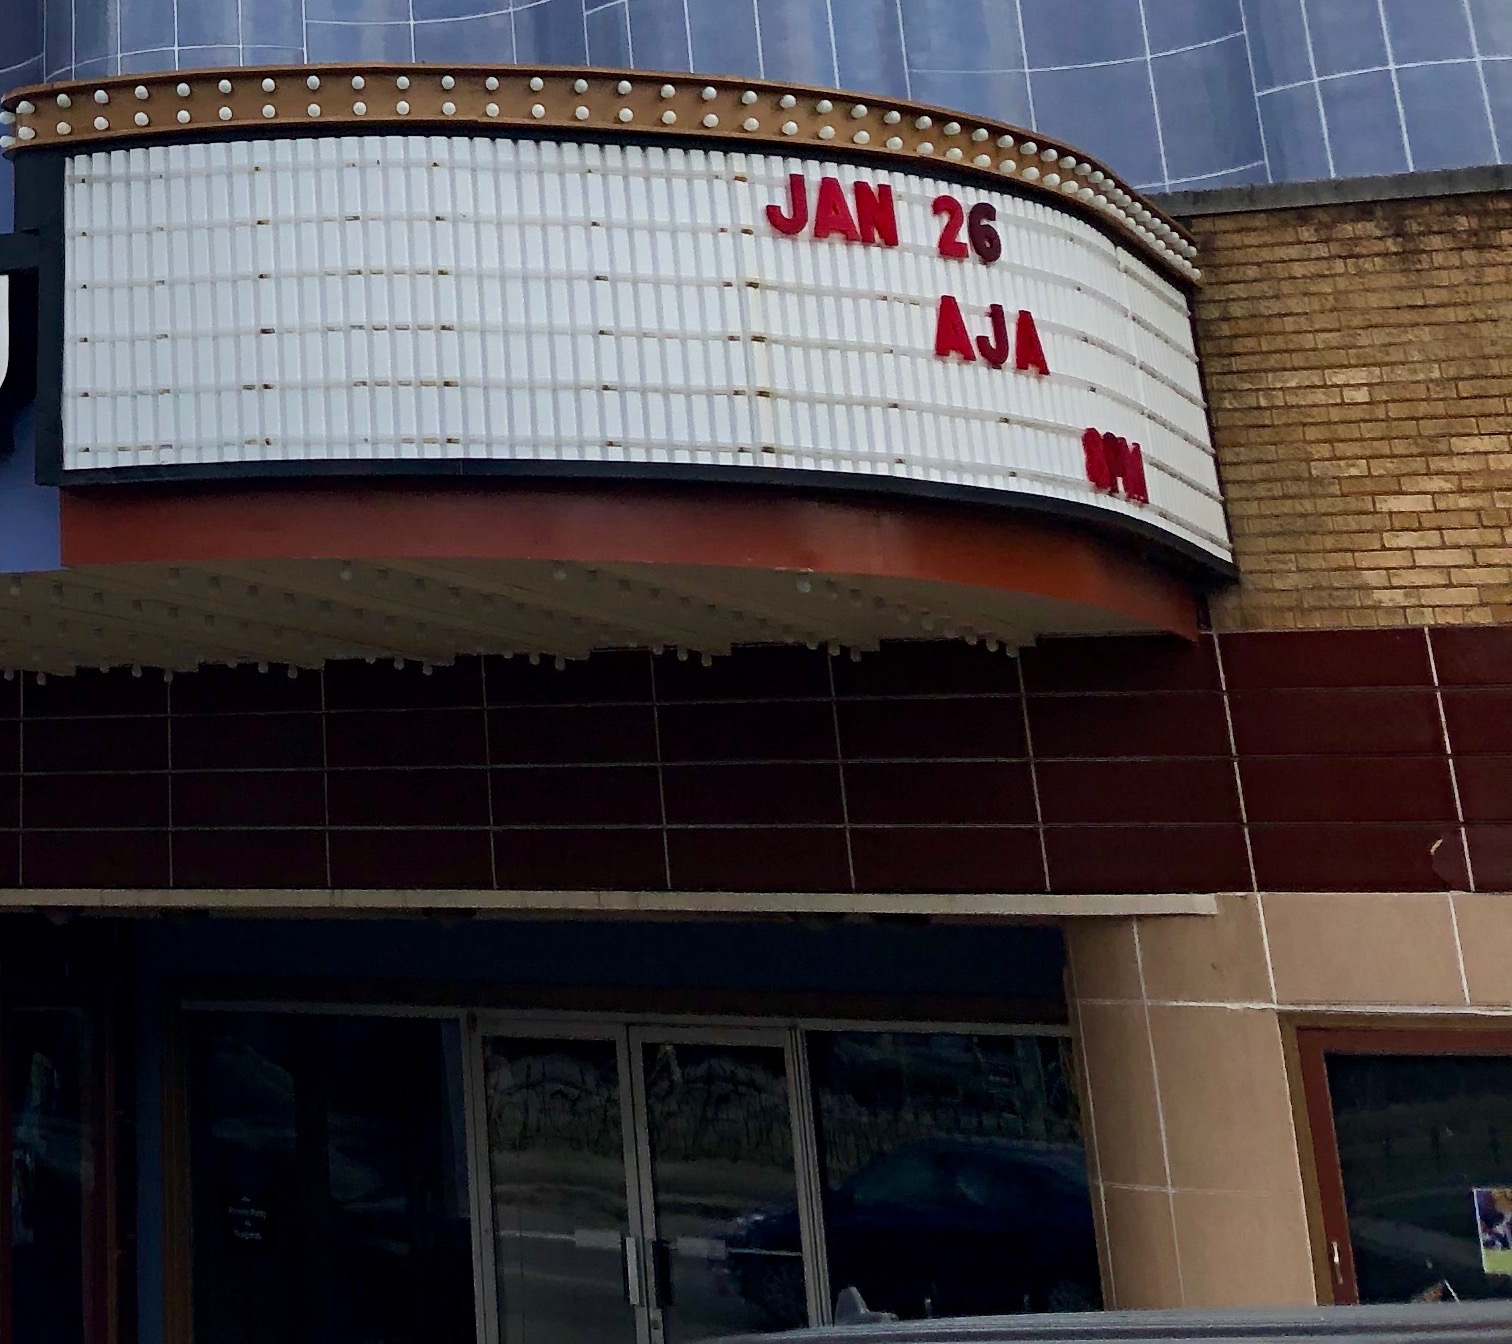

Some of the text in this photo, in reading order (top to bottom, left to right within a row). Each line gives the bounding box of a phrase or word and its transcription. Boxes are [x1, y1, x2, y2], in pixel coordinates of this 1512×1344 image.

[765, 173, 1003, 265] JAN 26
[934, 294, 1051, 377] AJA
